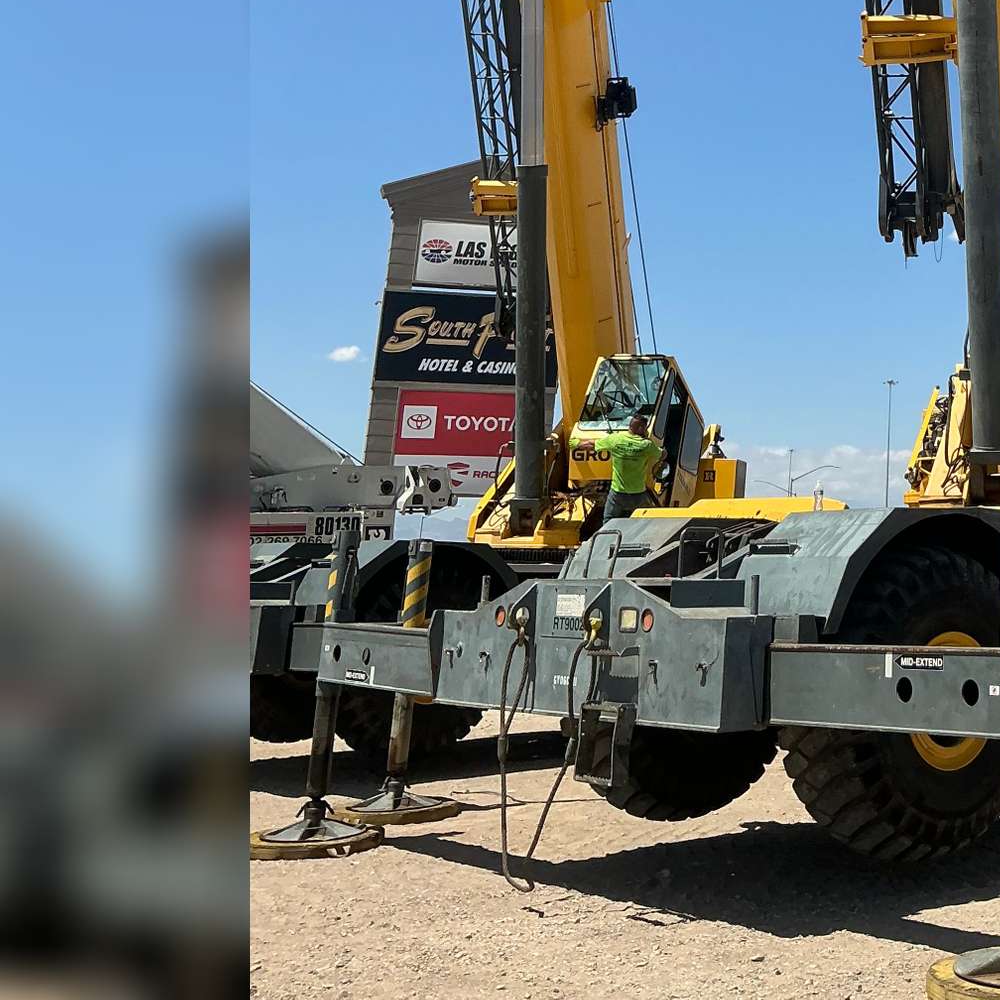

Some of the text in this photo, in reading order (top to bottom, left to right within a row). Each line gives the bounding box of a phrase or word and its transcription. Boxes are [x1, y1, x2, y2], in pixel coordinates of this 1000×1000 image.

[455, 240, 487, 259] LAS
[453, 258, 487, 267] MOTOR
[417, 358, 460, 373] HOTEL
[462, 360, 474, 373] &
[572, 449, 611, 462] GRO
[472, 470, 497, 479] RAC
[900, 656, 943, 667] MID-EXTEND
